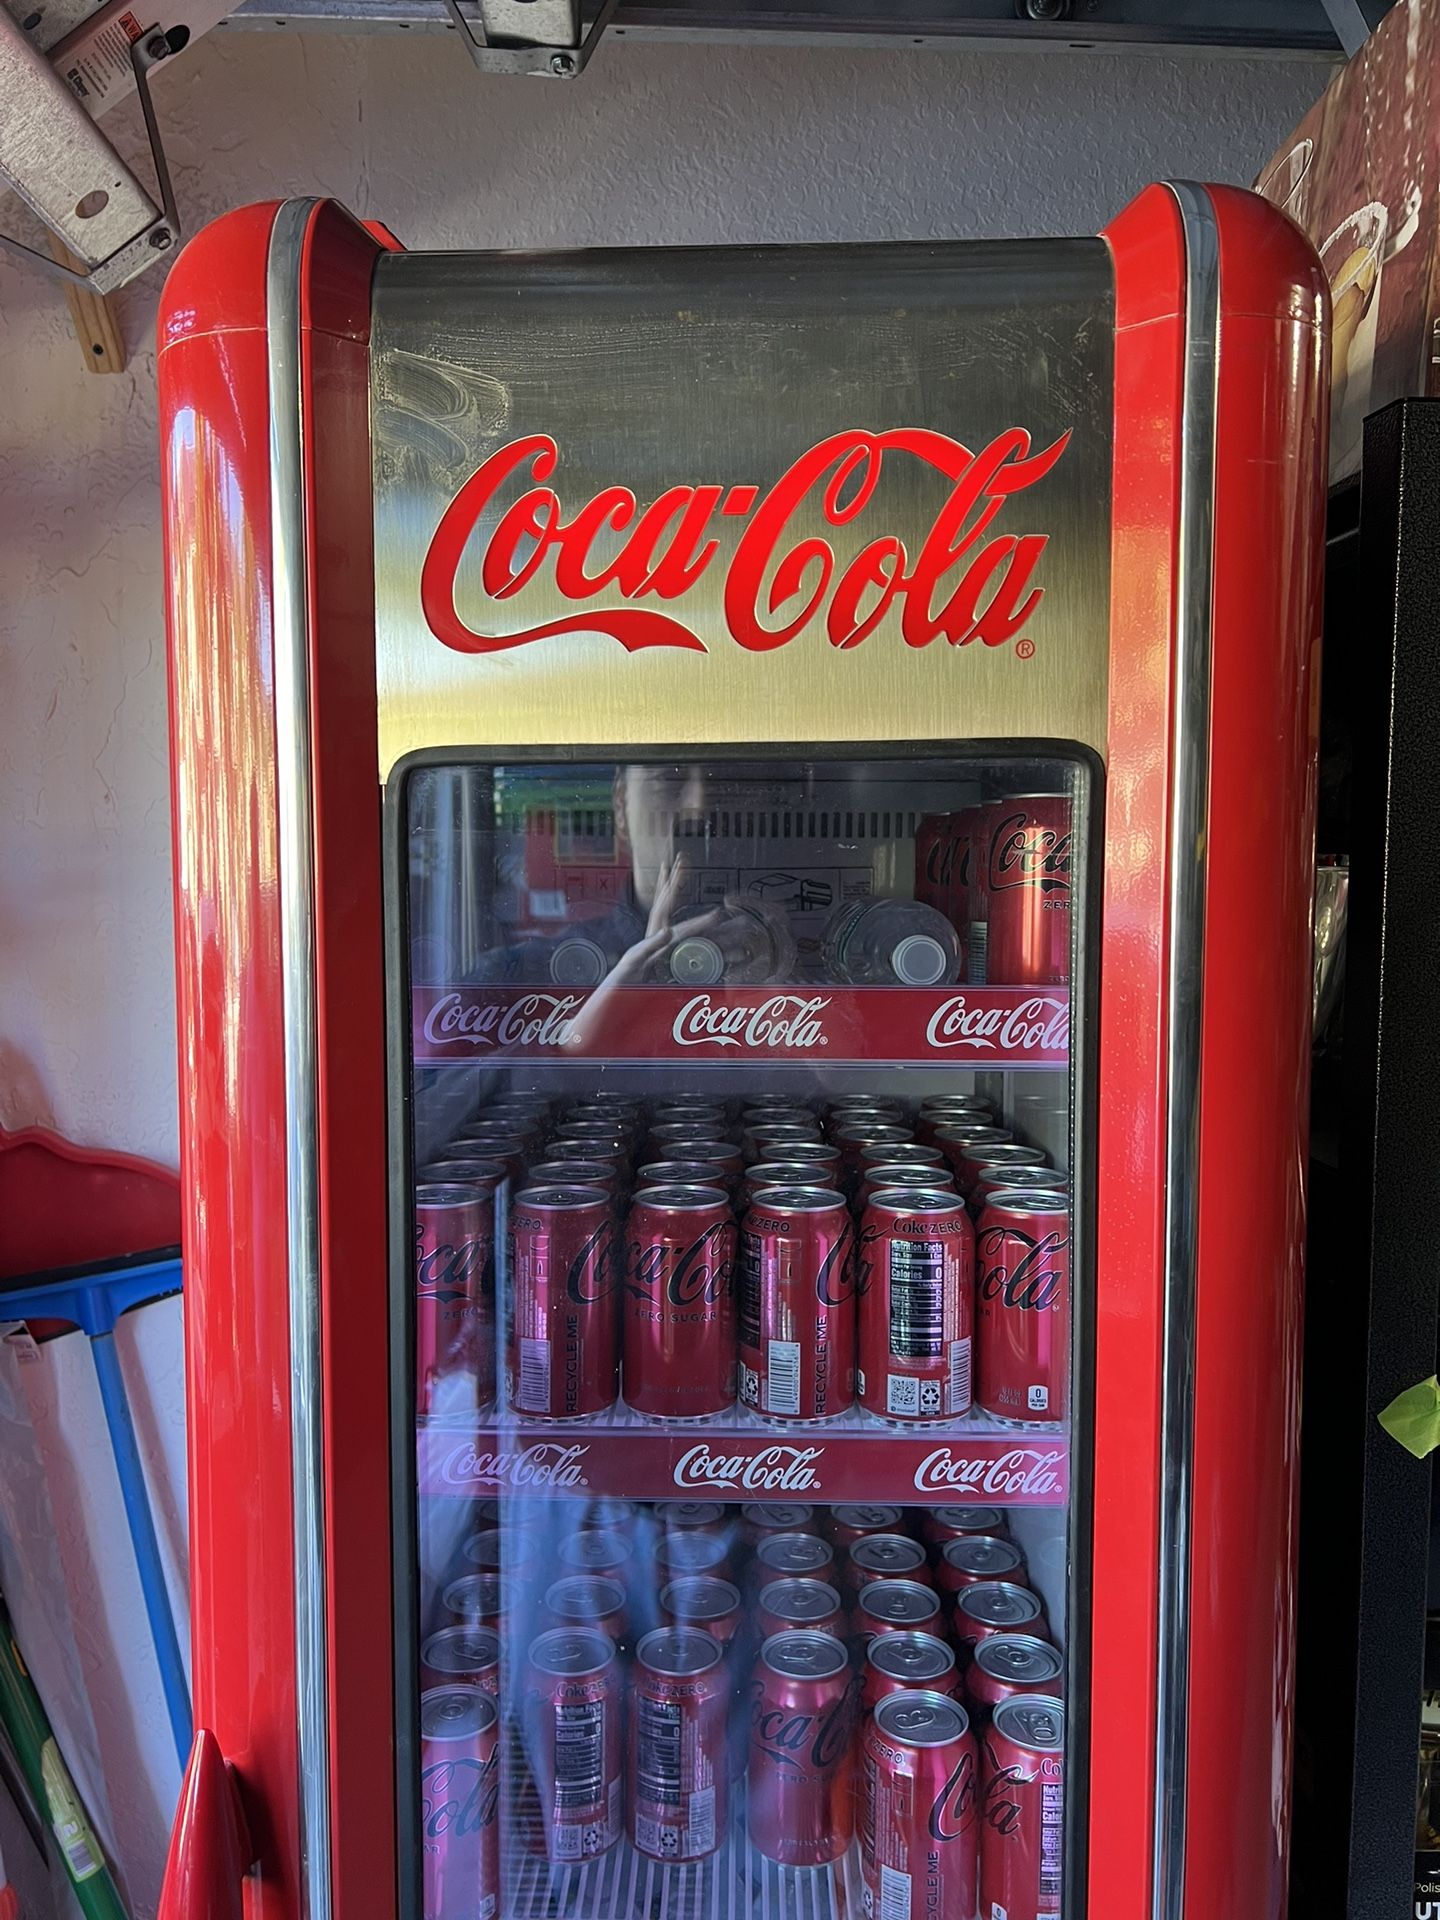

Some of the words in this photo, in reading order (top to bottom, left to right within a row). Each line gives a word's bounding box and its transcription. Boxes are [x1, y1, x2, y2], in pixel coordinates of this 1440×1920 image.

[421, 427, 1073, 655] Coca-Cola
[1043, 900, 1072, 910] ZER
[424, 993, 586, 1046] Coca-Cola
[673, 994, 832, 1047] Coca-Cola
[756, 1216, 791, 1232] ZERO
[893, 1216, 928, 1234] Coke
[929, 1219, 963, 1235] ZERO
[924, 1242, 943, 1253] Facts
[891, 1267, 923, 1279] Calories
[935, 1266, 943, 1279] 0
[567, 1315, 578, 1339] ME
[671, 1310, 717, 1322] SUGAR
[815, 1315, 828, 1339] ME
[567, 1341, 578, 1412] RECYCLE
[815, 1344, 828, 1414] RECYCLE
[1035, 1388, 1042, 1399] 0
[442, 1443, 590, 1487] Coca-Cola
[674, 1444, 825, 1490] Coca-Cola
[914, 1448, 1067, 1494] Coca-Cola
[927, 1877, 939, 1920] CYCLE
